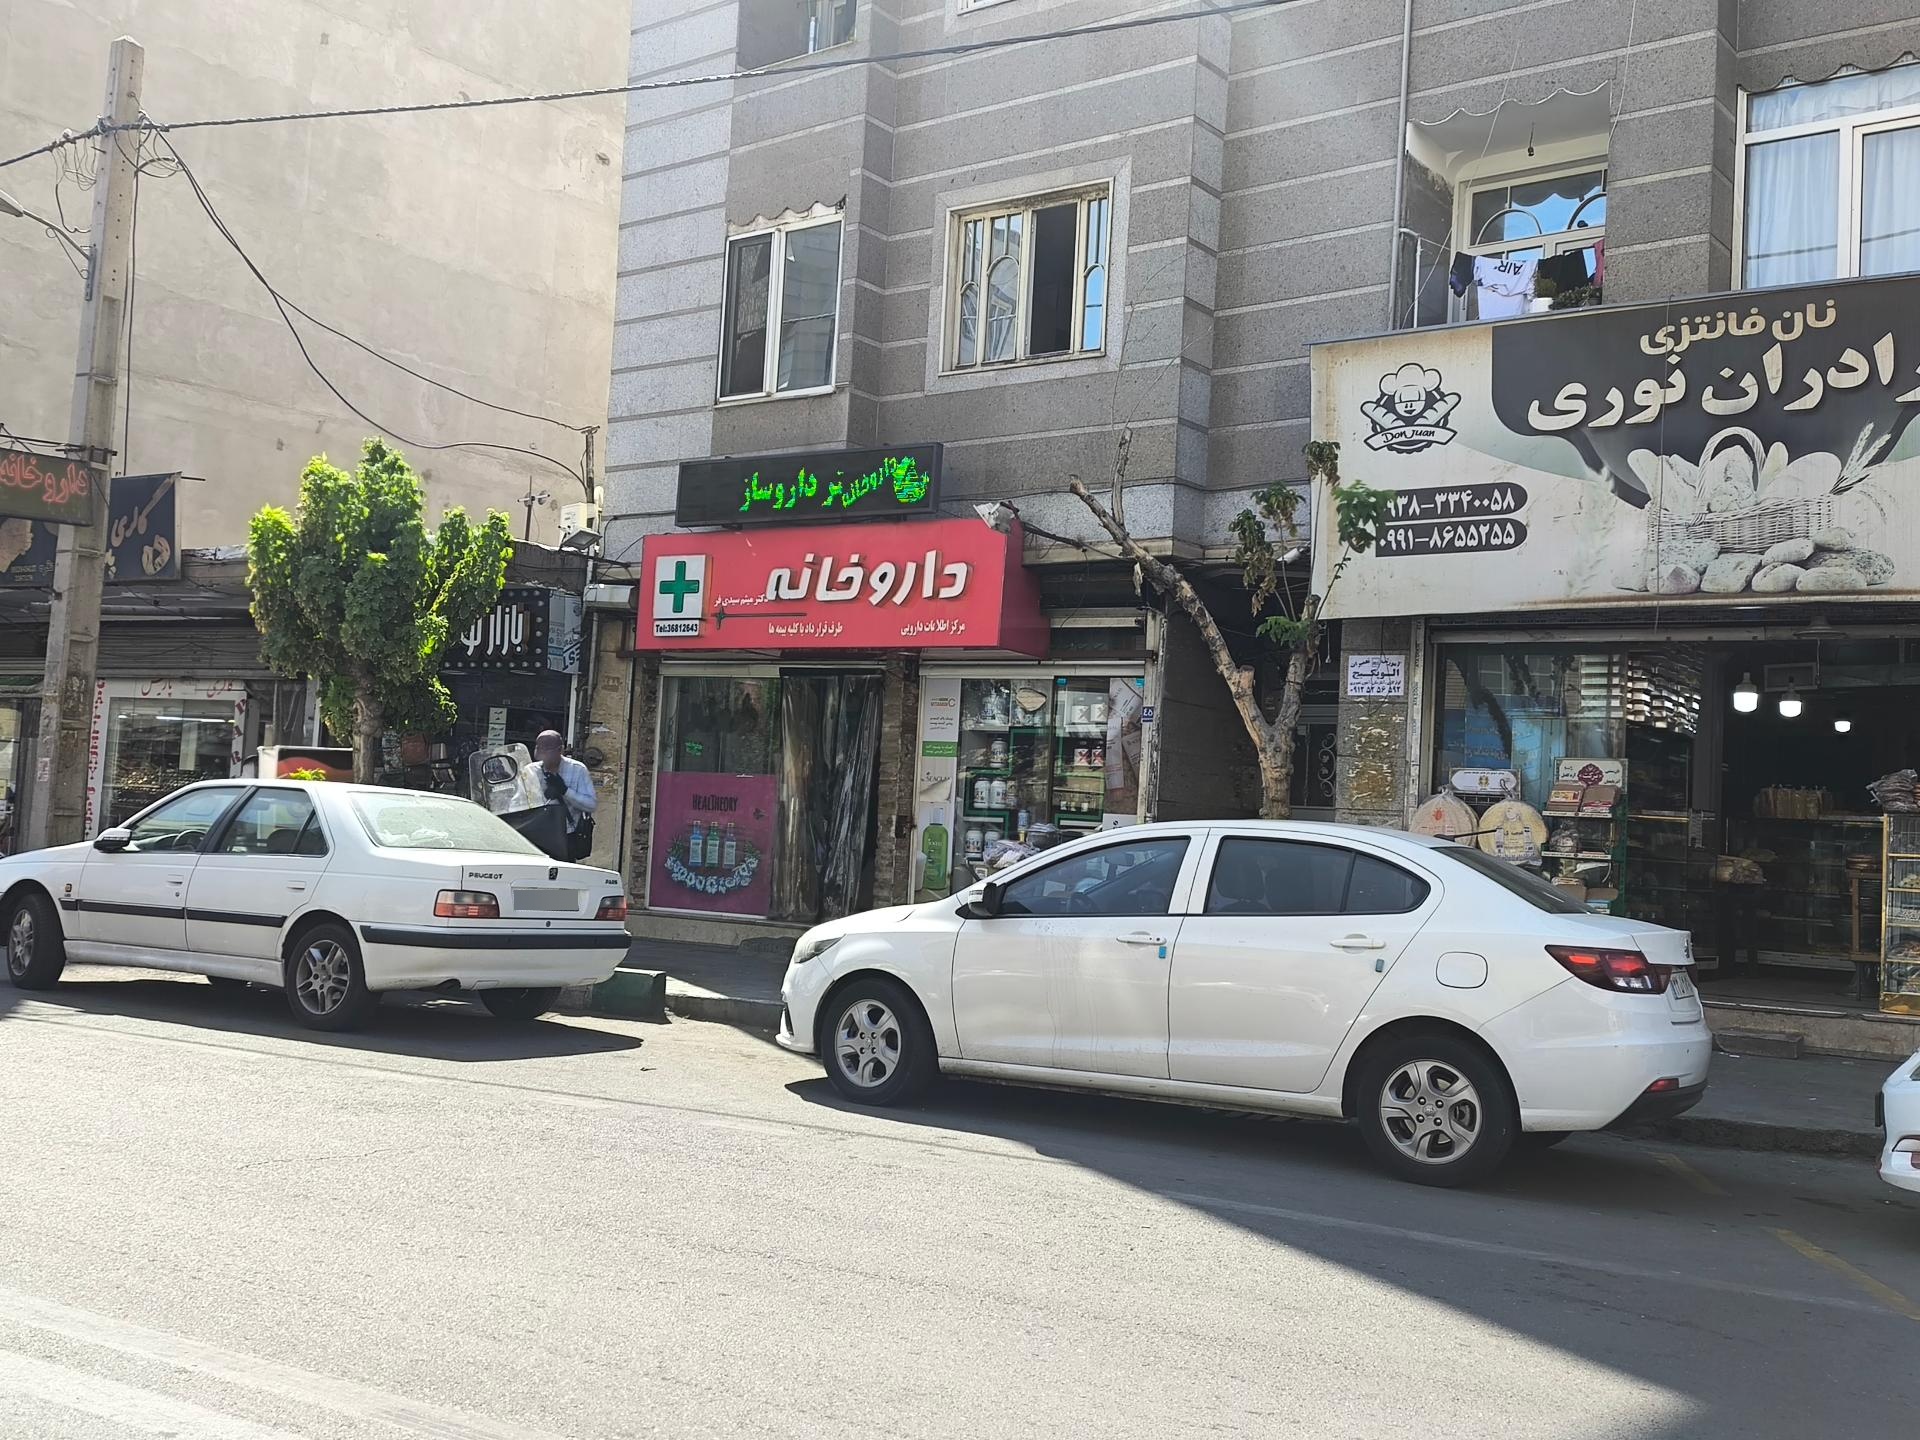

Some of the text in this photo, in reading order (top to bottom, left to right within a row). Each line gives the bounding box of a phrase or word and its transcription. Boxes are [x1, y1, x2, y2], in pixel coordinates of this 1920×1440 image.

[1639, 298, 1837, 356] نان فانتزی
[1527, 332, 1920, 432] رادران نوری
[1381, 429, 1436, 443] Don Juan
[738, 466, 819, 513] داروساز
[765, 549, 969, 606] داروخانه
[740, 594, 753, 606] میثم
[486, 604, 524, 656] بازار
[768, 622, 775, 633] ها
[775, 624, 787, 637] بیمه
[787, 622, 800, 636] کلیه
[804, 622, 815, 633] داد
[815, 620, 828, 637] قرار
[828, 620, 843, 637] طرف
[900, 618, 966, 636] مرکز اطلاعات دارویی
[468, 871, 504, 880] PEUGEOT
